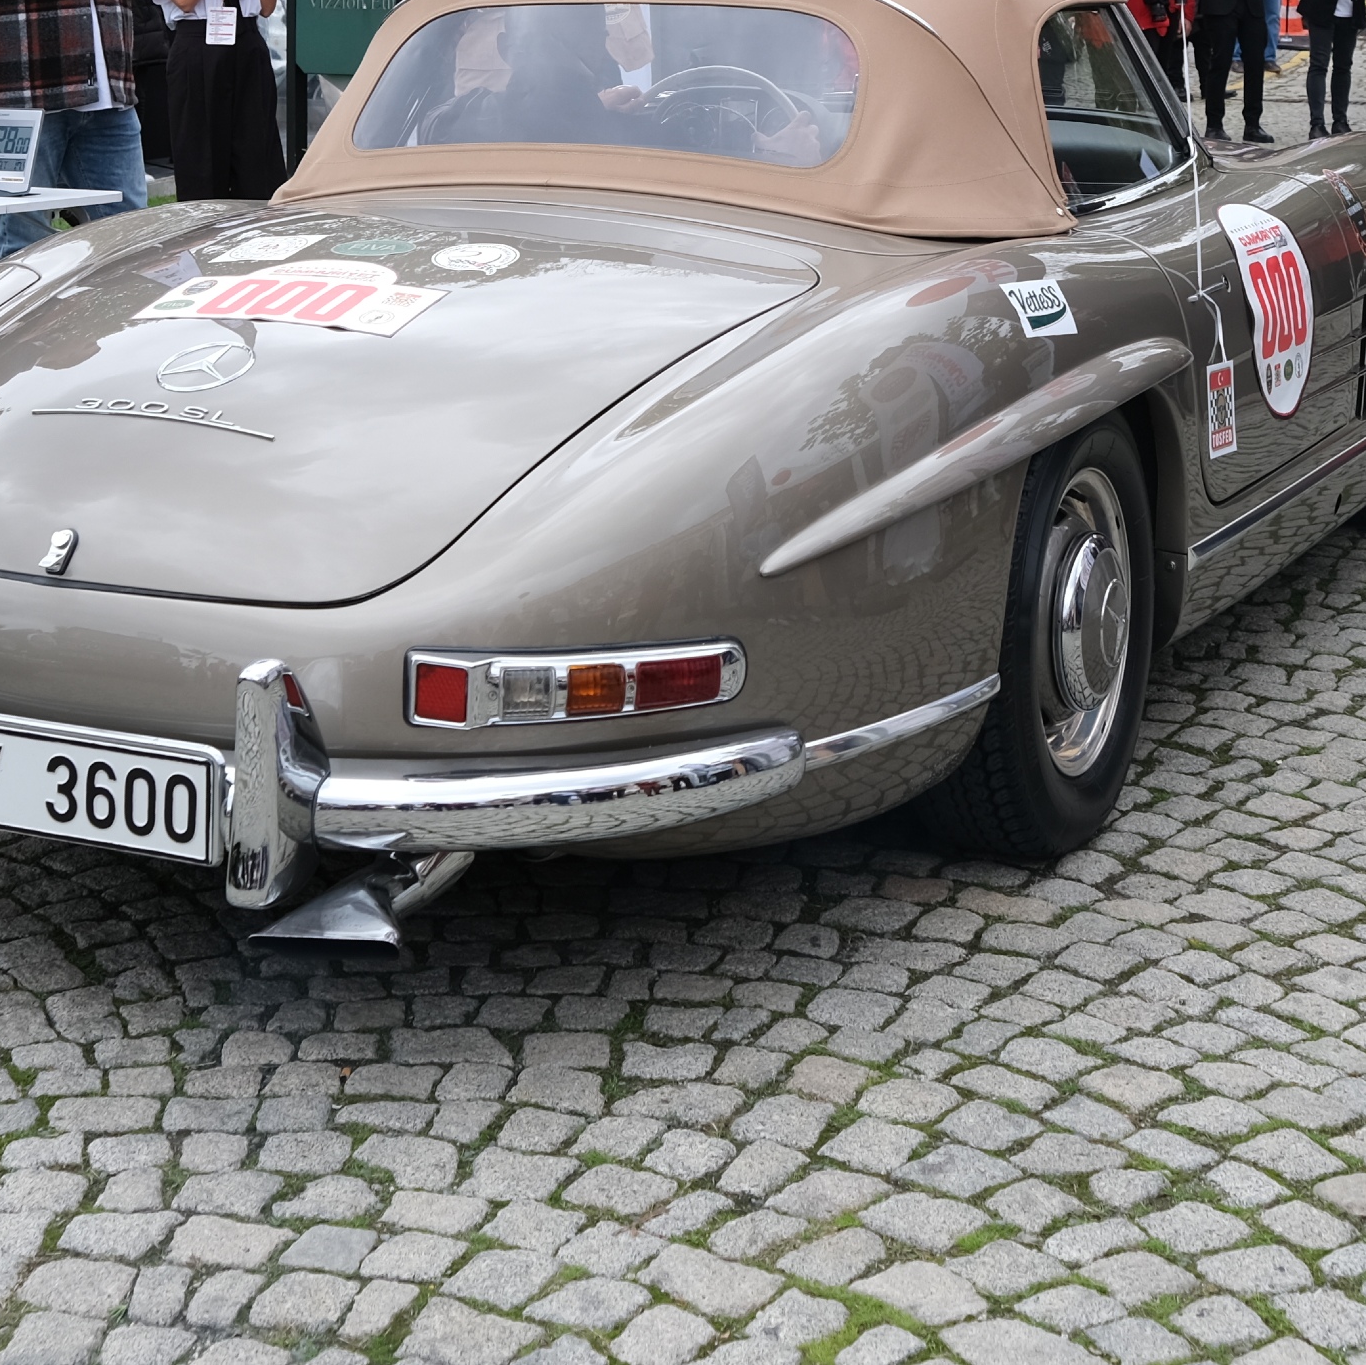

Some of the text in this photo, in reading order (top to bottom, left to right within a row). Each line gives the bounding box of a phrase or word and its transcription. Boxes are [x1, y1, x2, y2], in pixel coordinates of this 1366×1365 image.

[75, 397, 235, 426] 300 SL
[1212, 425, 1234, 448] TOSFED
[45, 755, 197, 843] 3600
